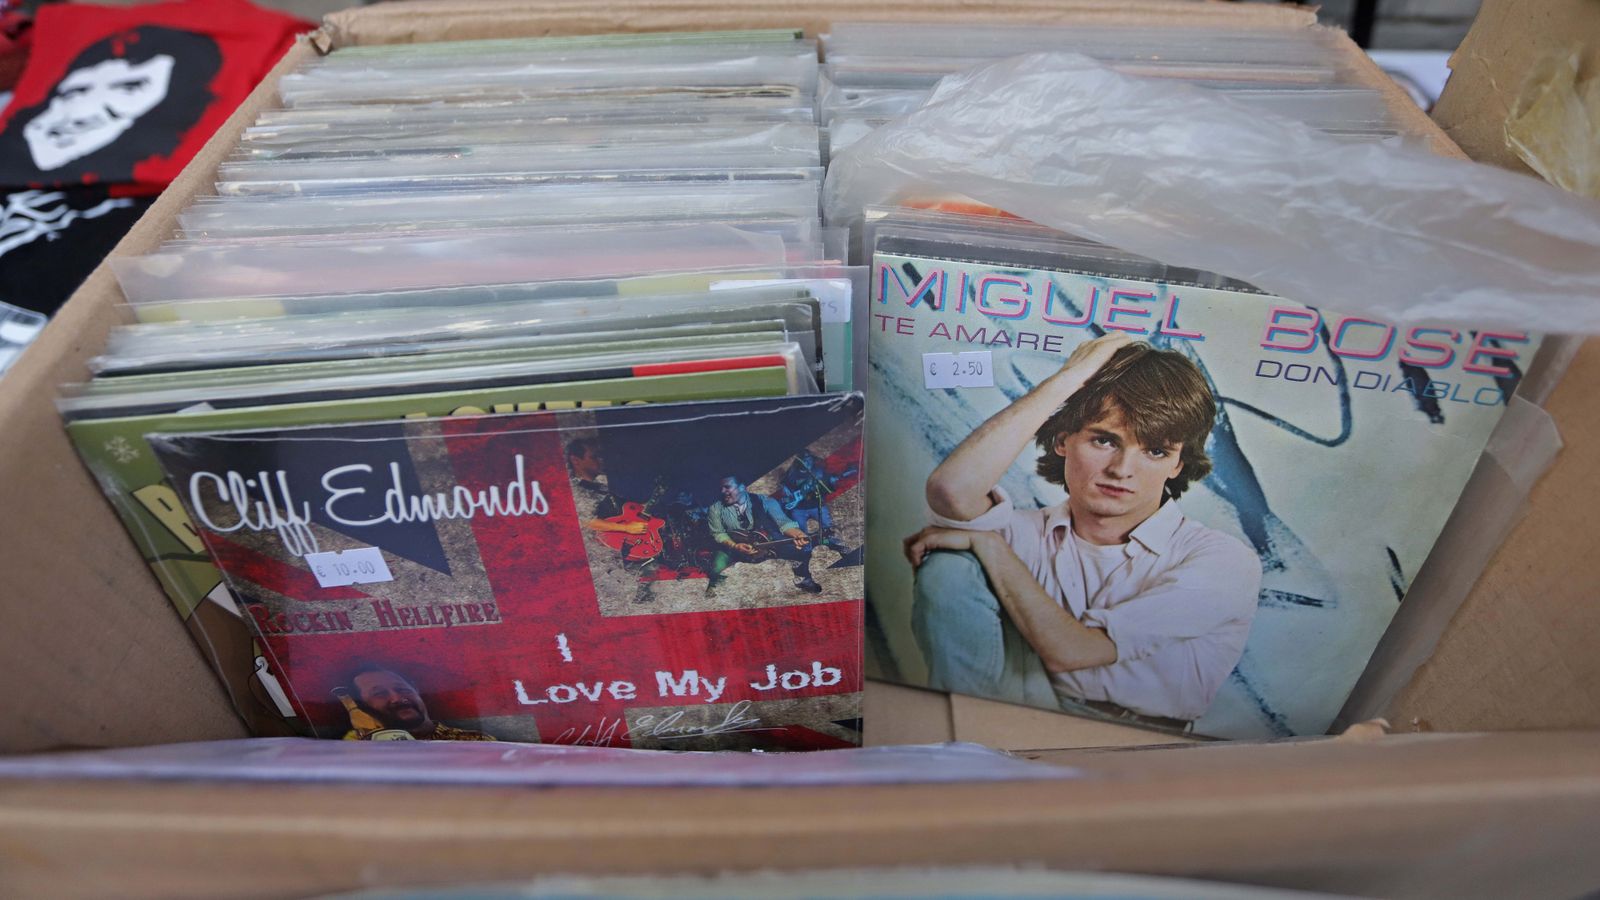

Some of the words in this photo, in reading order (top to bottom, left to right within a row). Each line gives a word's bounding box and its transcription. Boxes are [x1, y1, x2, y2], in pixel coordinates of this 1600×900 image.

[874, 313, 916, 336] TE
[928, 321, 1064, 353] AMARE
[877, 263, 1206, 342] MIGUEL
[1260, 304, 1530, 377] BOSE
[929, 361, 938, 377] €
[951, 361, 983, 377] 2.50
[1255, 359, 1339, 386] DON
[1353, 370, 1504, 407] DIABLO
[190, 470, 320, 556] Cliff
[320, 454, 550, 526] Edmonds
[315, 564, 327, 578] €
[332, 560, 376, 577] 10.00
[556, 631, 574, 662] I
[513, 678, 637, 705] Love
[655, 669, 727, 704] My
[749, 660, 843, 692] Job
